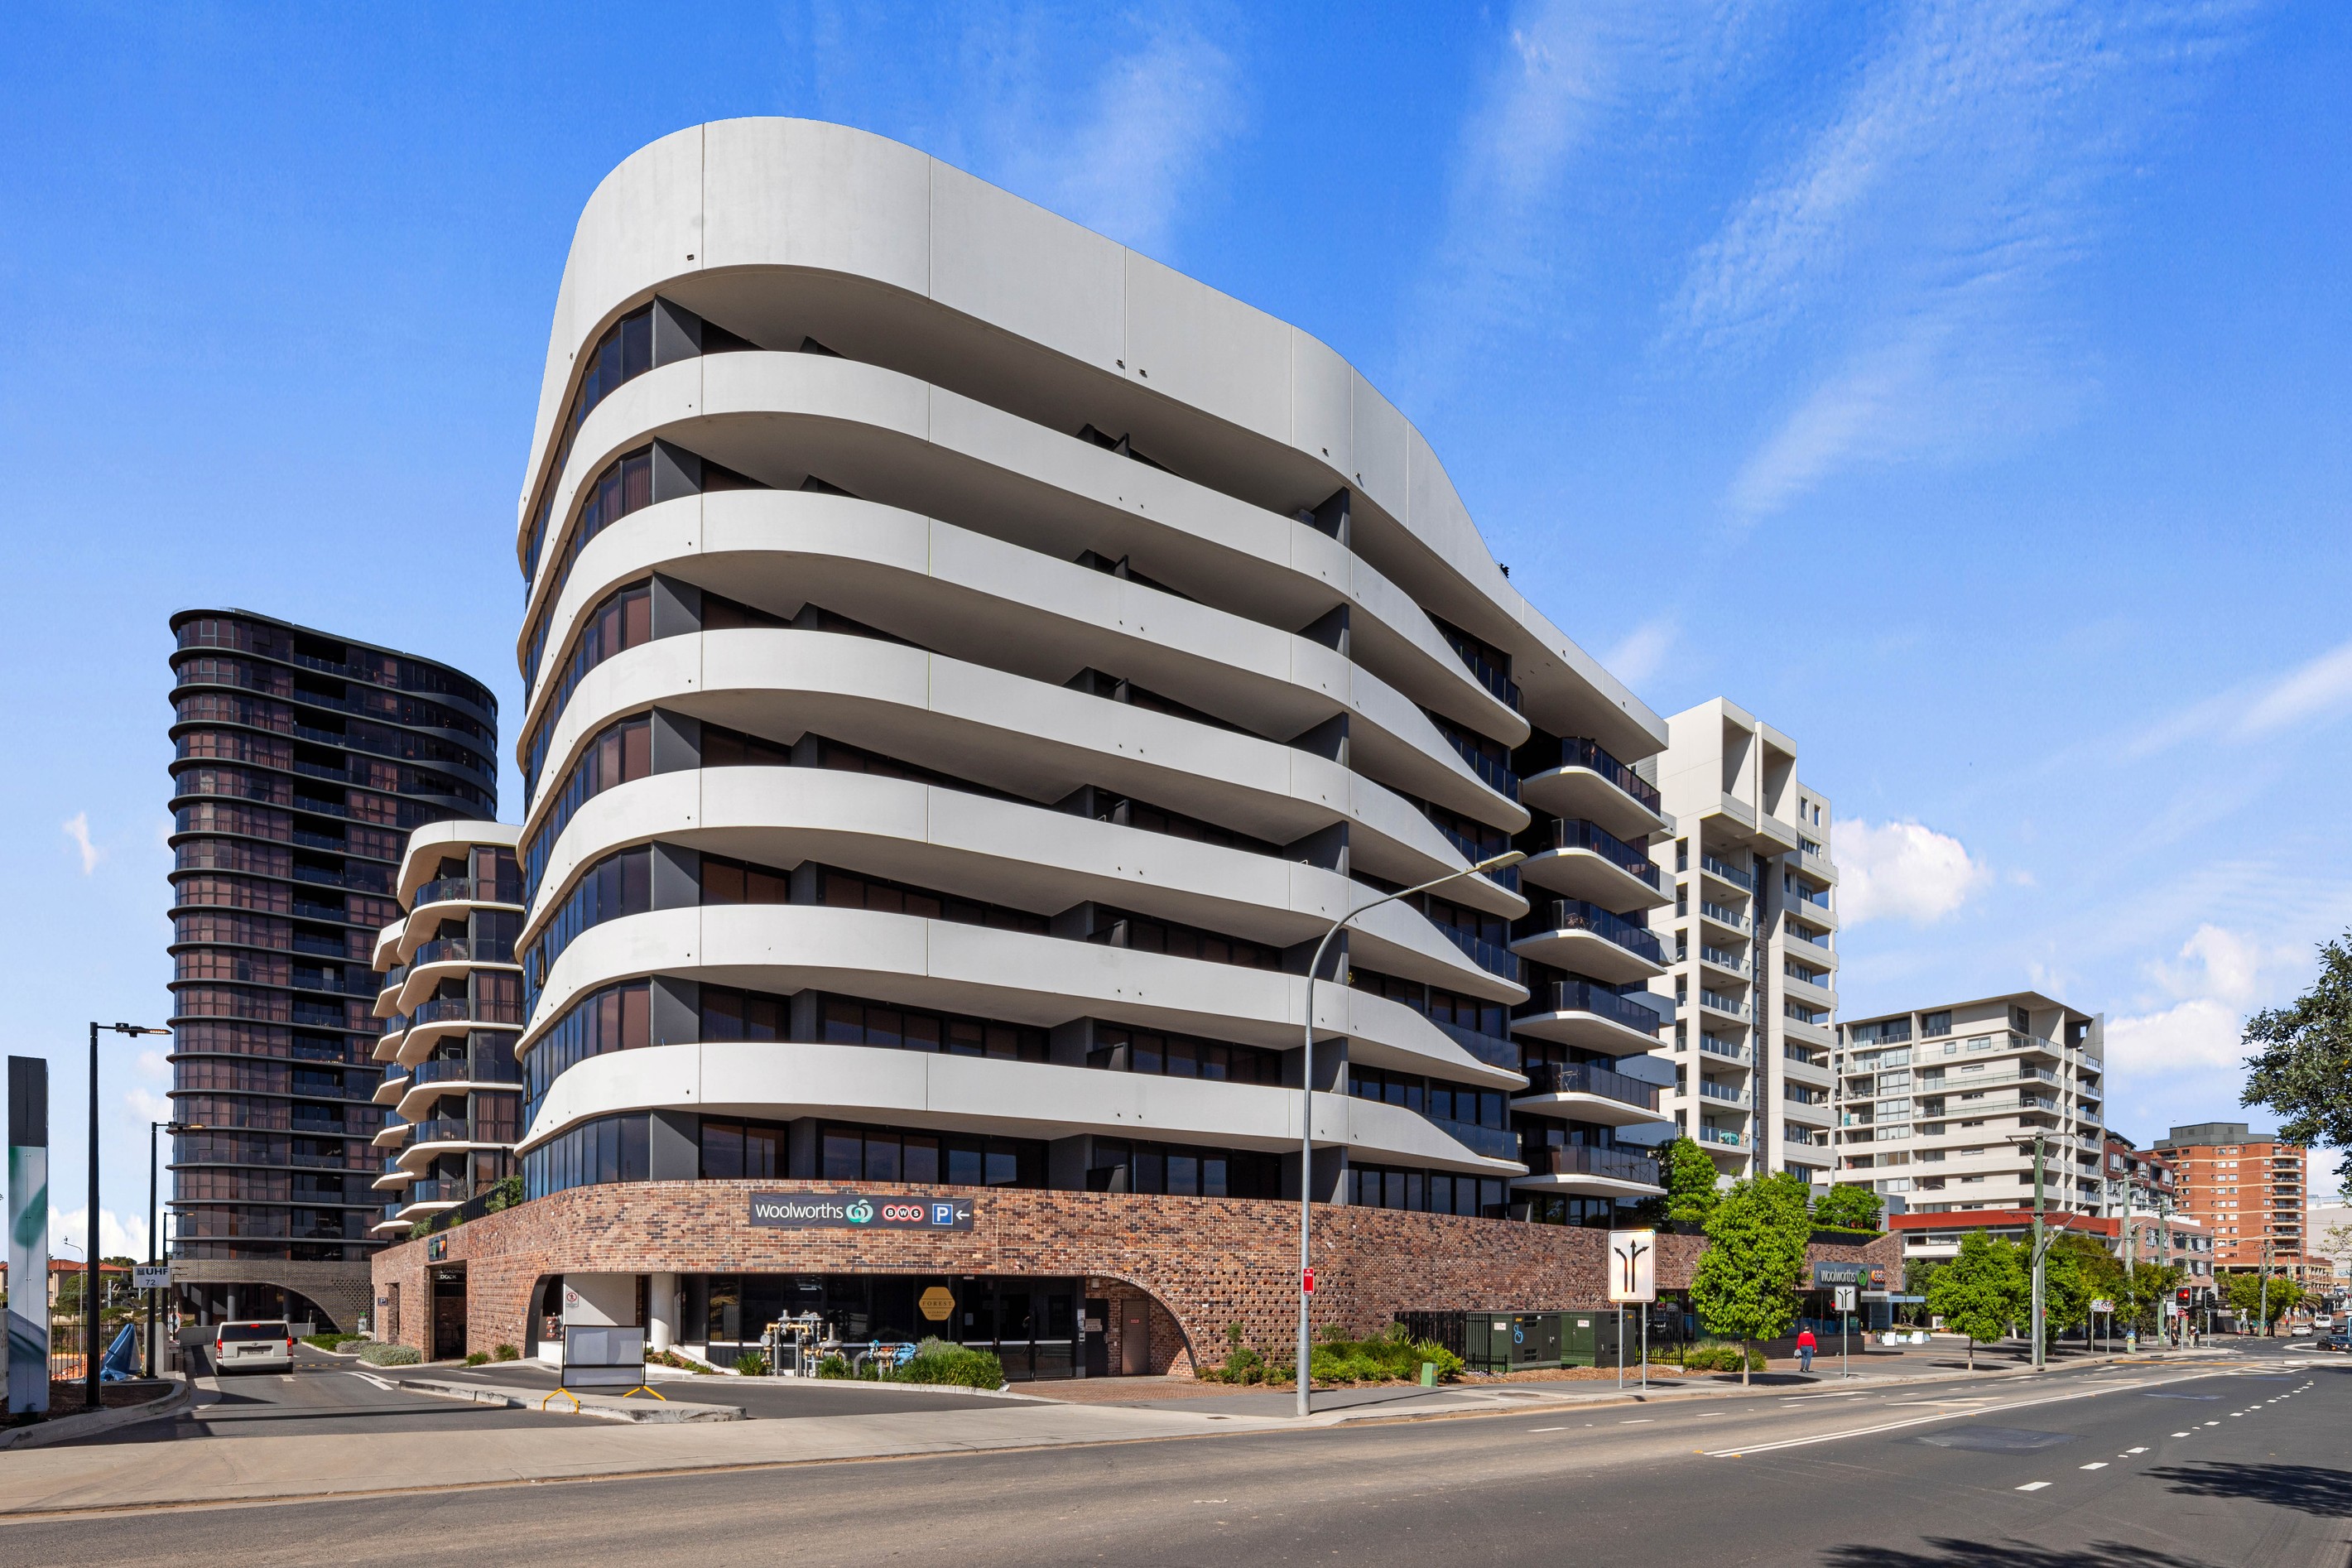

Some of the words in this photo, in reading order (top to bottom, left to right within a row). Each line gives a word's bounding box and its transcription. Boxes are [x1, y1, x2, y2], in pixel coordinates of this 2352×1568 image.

[755, 1202, 843, 1219] Woolworths
[884, 1207, 921, 1219] BWS
[936, 1206, 949, 1222] P
[1821, 1268, 1855, 1282] Woolworths
